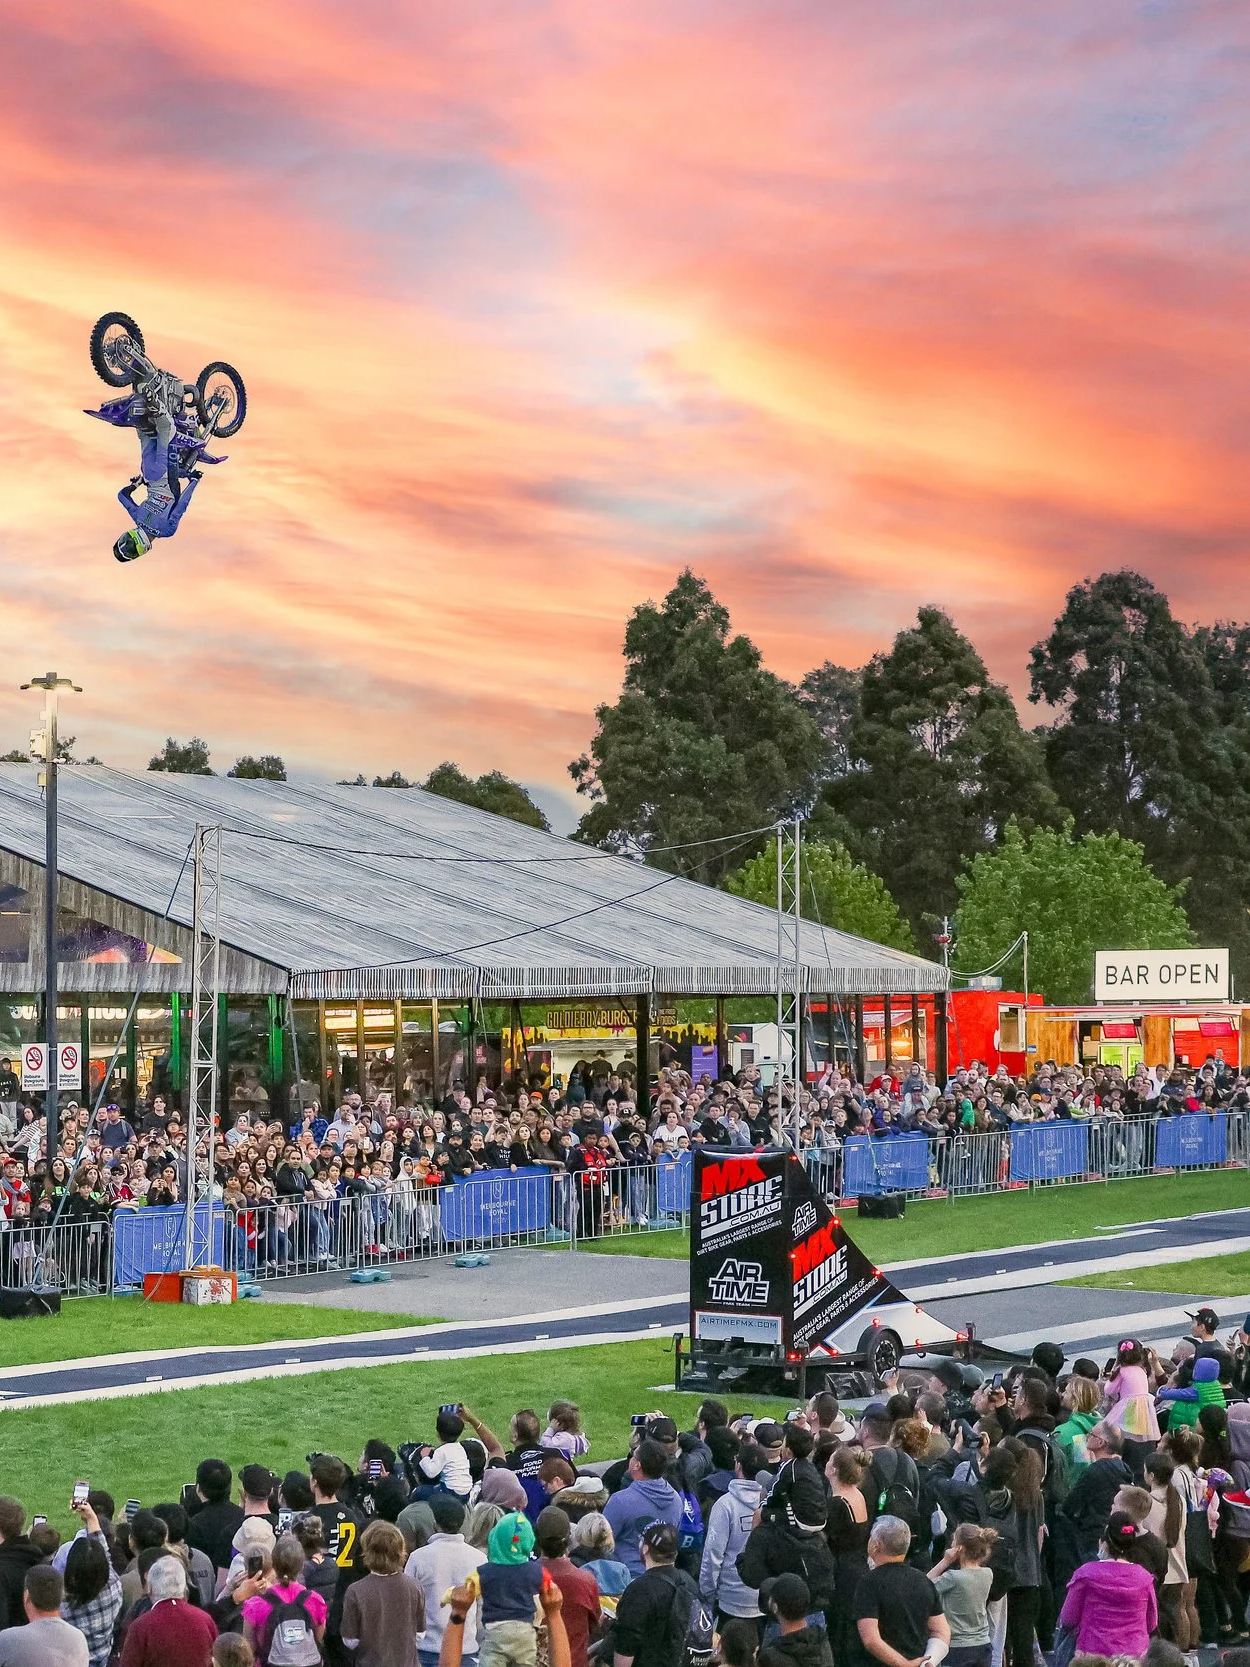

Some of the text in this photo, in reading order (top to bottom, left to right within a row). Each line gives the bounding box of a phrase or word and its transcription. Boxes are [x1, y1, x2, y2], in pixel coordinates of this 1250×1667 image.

[1106, 964, 1219, 985] BAR OPEN
[547, 1011, 598, 1029] GOLDIEBOY
[701, 1158, 766, 1202] MX
[701, 1175, 783, 1228] STORE
[794, 1201, 812, 1224] AIR
[701, 1233, 731, 1248] AUSTRALIA'S
[730, 1226, 751, 1237] LARGEST
[750, 1219, 767, 1230] RANGE
[792, 1207, 817, 1237] TIME
[696, 1245, 708, 1255] DIRT
[708, 1242, 719, 1252] BIKE
[733, 1232, 748, 1243] PARTS
[751, 1219, 783, 1235] ACCESSORIES
[793, 1219, 837, 1283] MX
[716, 1258, 762, 1282] AIR
[794, 1244, 848, 1309] STORE
[709, 1277, 769, 1303] TIME
[793, 1314, 822, 1341] AUSTRALIA'S
[822, 1297, 842, 1319] LARGEST
[842, 1285, 858, 1303] RANGE
[805, 1328, 816, 1341] BIKE
[830, 1304, 845, 1321] PARTS
[848, 1275, 879, 1304] ACCESSORIES
[700, 1318, 777, 1328] AIRTIMEFMX.COM
[524, 1459, 542, 1468] FORD
[336, 1522, 356, 1567] 2
[681, 1535, 694, 1548] B
